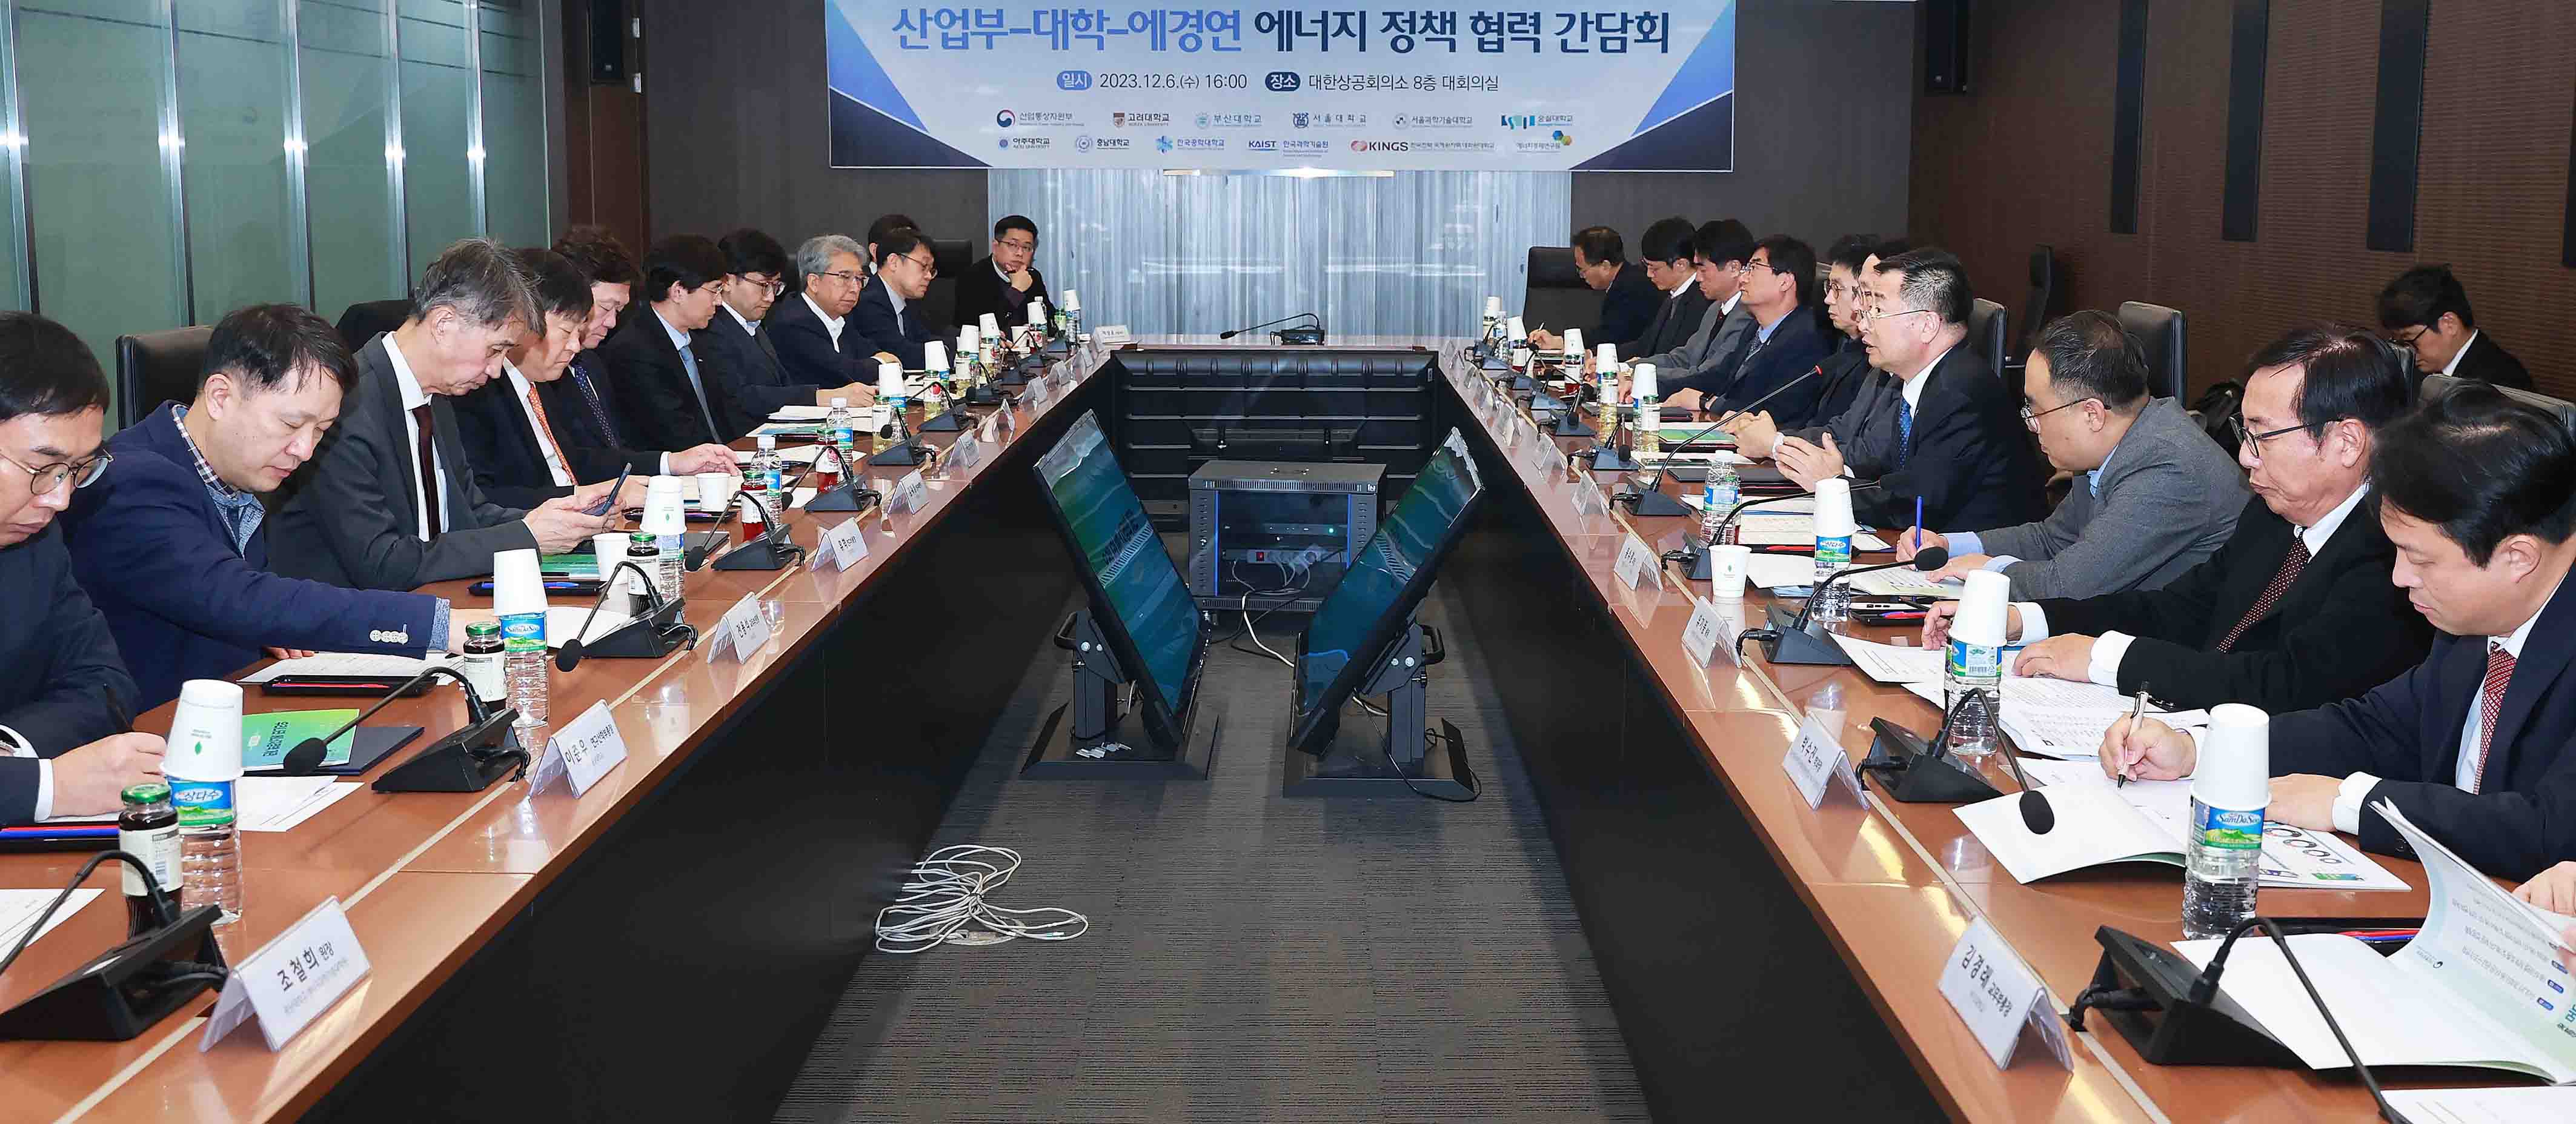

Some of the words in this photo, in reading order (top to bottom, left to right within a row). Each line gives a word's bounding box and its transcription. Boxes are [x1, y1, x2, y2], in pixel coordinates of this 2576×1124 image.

[892, 8, 1241, 53] 산업부-대학-에경연
[1254, 10, 1367, 53] 에너지
[1380, 10, 1456, 53] 정책
[1469, 11, 1541, 53] 협력
[1555, 12, 1669, 54] 간담회
[1062, 72, 1088, 88] 일시
[1100, 73, 1200, 90] 2023.12.6.(수)
[1205, 73, 1247, 89] 16:00
[1270, 73, 1297, 90] 장소
[1309, 74, 1409, 91] 대한상공회의소
[1413, 75, 1436, 91] 8층
[1442, 75, 1499, 91] 대회의실
[1128, 112, 1170, 122] 고려대학교
[1213, 115, 1262, 123] 부산대학교
[1313, 114, 1367, 123] 서울대학교
[1369, 142, 1409, 151] KINGS
[565, 739, 587, 765] 이준우
[276, 945, 320, 992] 조철희
[319, 940, 334, 960] 원장
